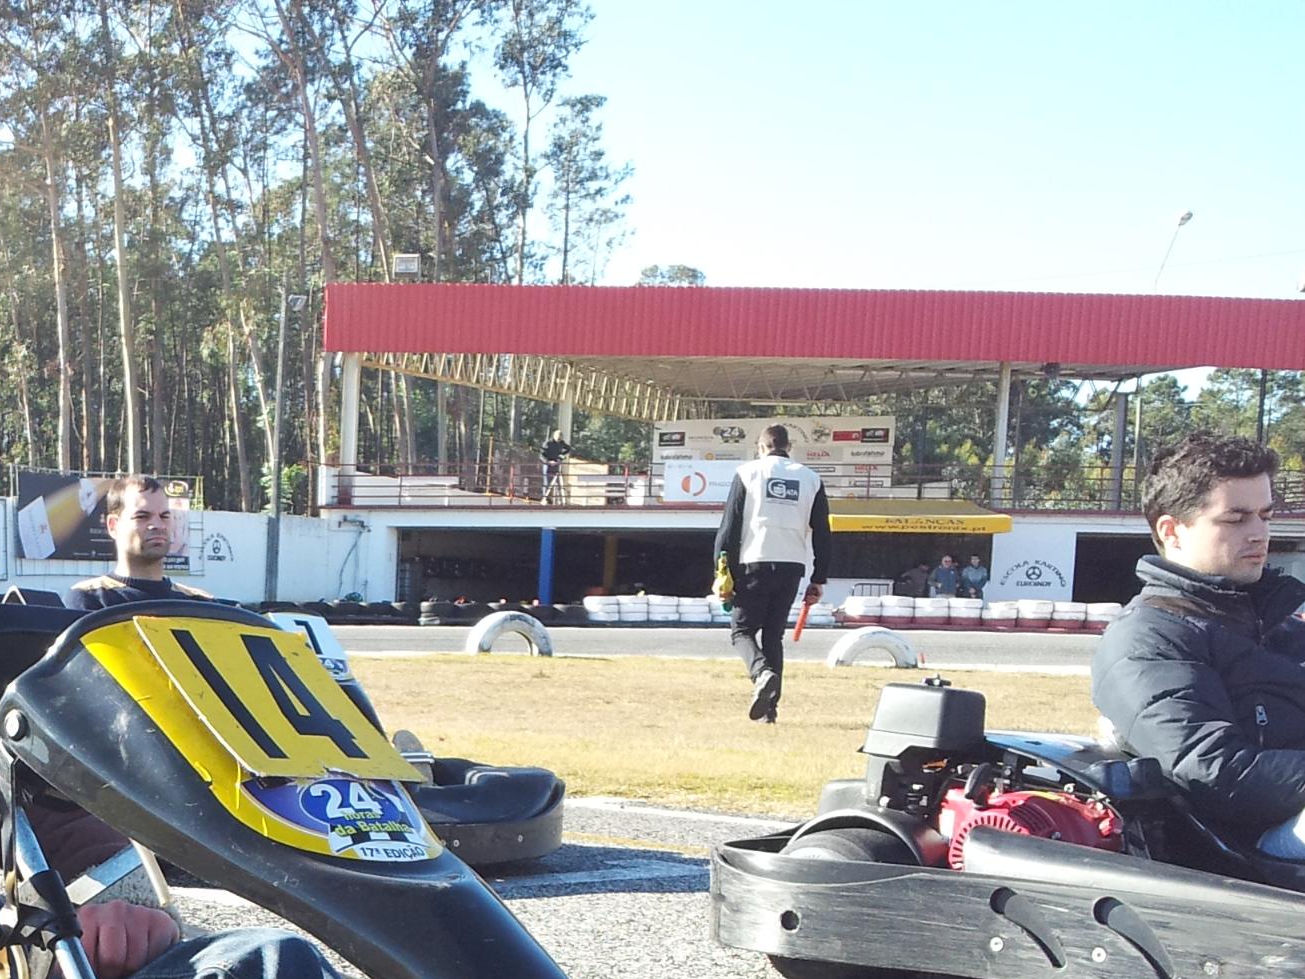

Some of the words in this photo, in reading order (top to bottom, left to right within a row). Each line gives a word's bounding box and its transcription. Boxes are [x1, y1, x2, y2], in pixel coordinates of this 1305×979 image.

[170, 629, 369, 760] 14
[309, 782, 383, 819] 24
[333, 823, 357, 838] da
[357, 820, 413, 834] Batalha
[386, 845, 426, 859] EDIÇÃO
